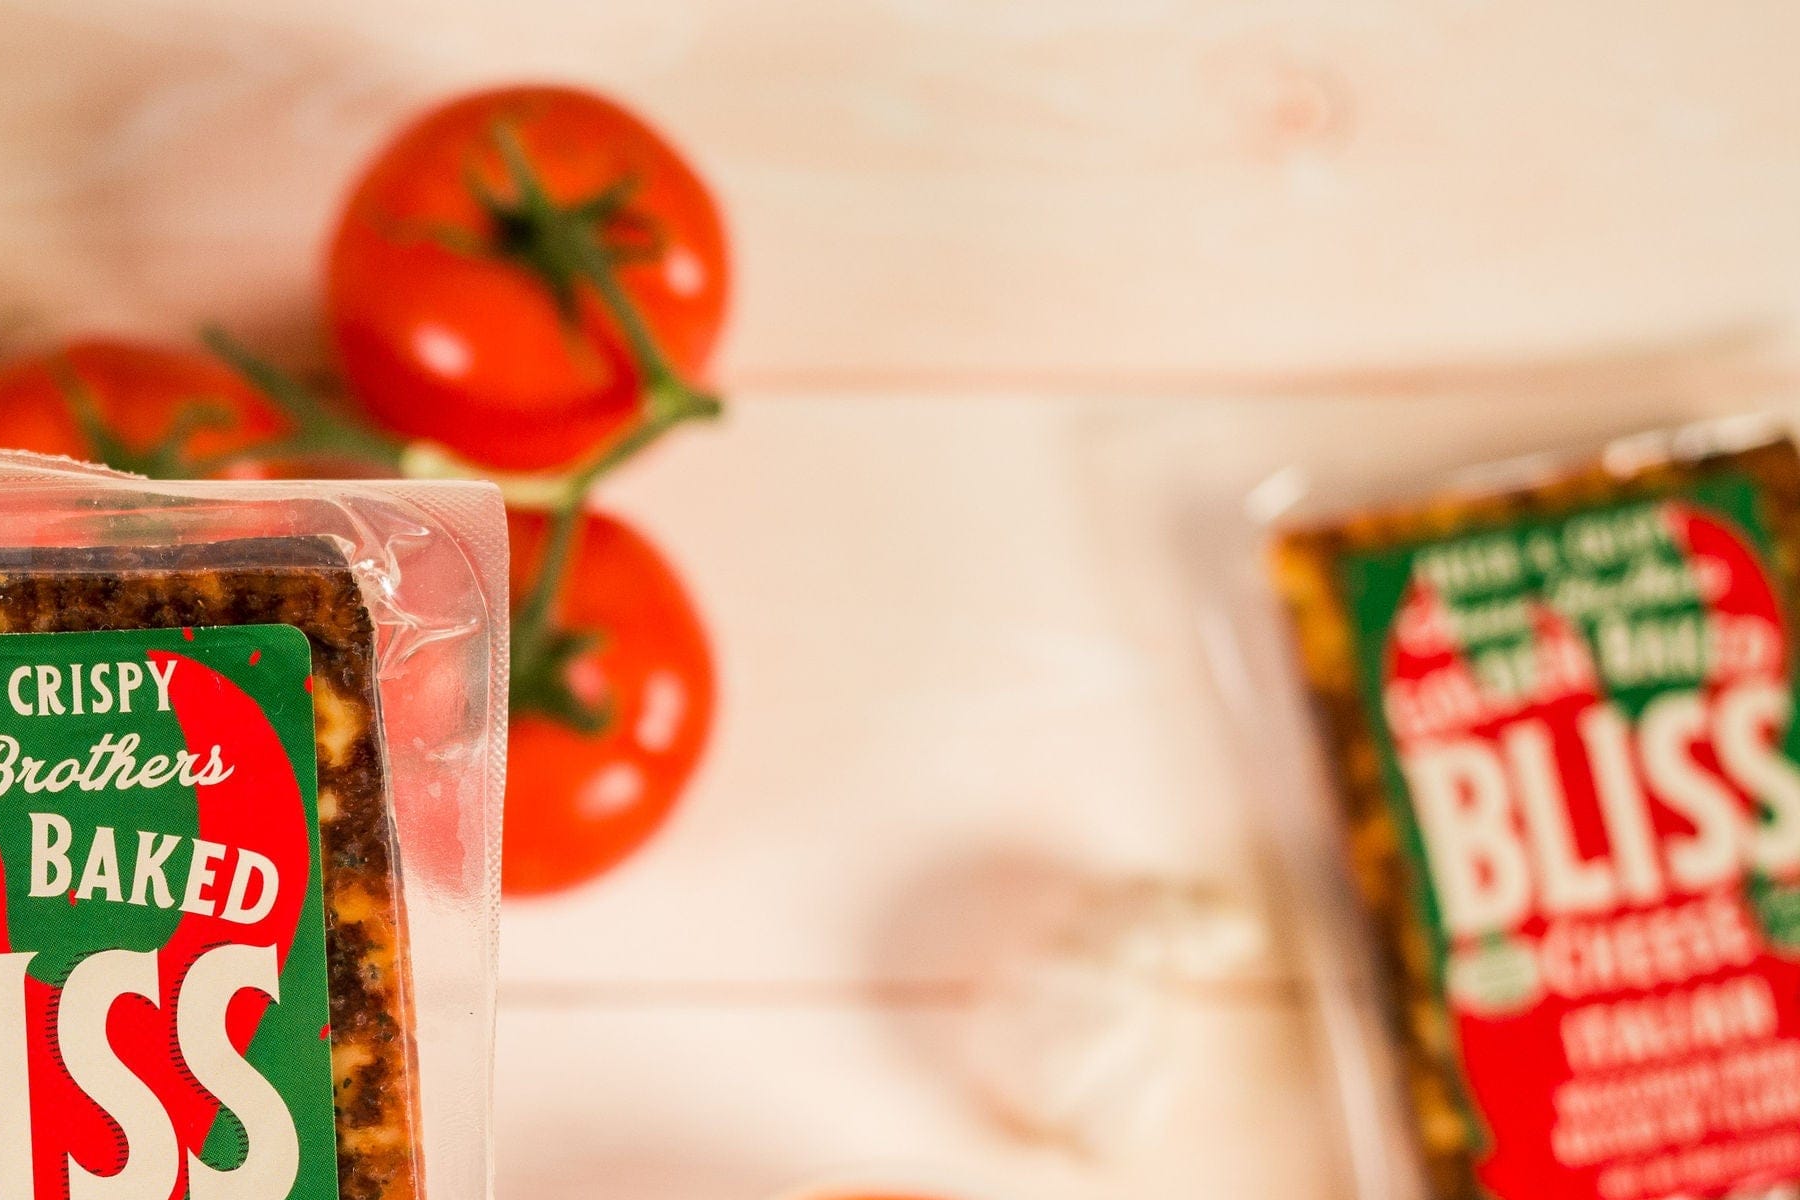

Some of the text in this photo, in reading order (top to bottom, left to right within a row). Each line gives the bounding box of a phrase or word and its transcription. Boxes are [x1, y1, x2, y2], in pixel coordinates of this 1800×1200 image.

[9, 659, 179, 716] CRISPY
[1400, 682, 1800, 935] BLISS
[28, 813, 280, 925] BAKED
